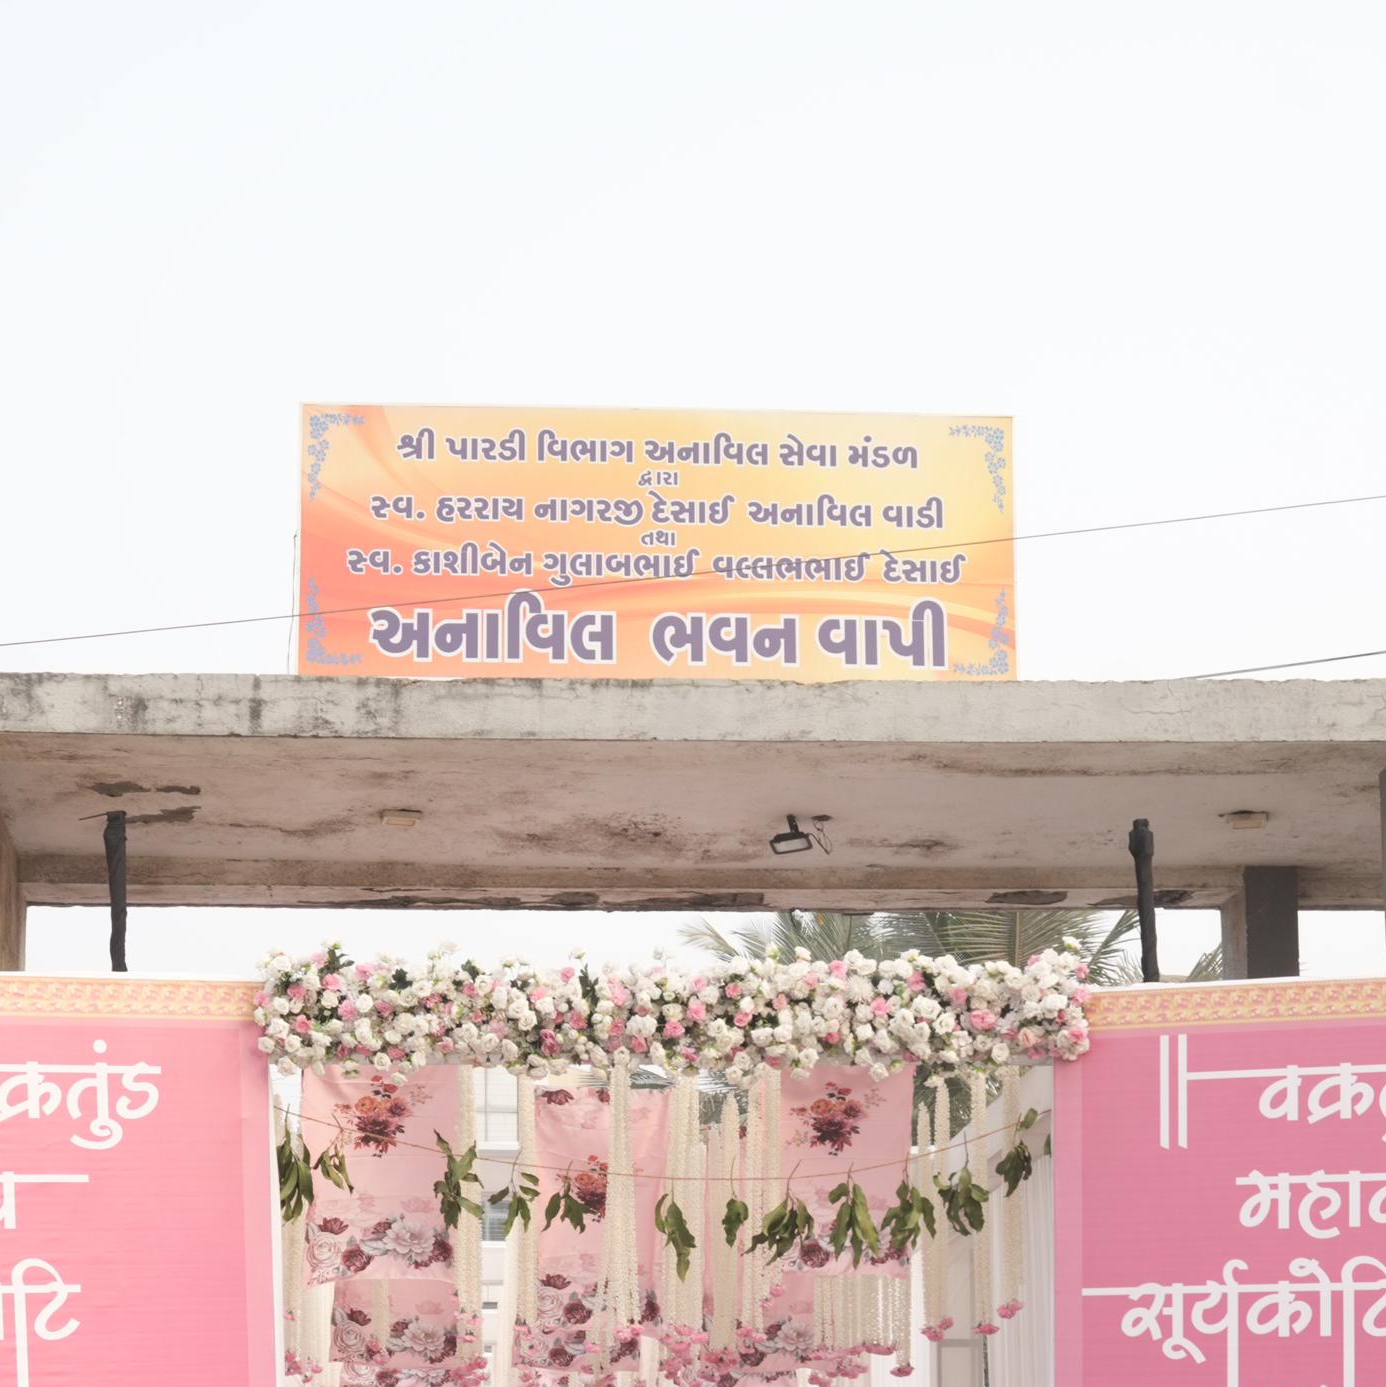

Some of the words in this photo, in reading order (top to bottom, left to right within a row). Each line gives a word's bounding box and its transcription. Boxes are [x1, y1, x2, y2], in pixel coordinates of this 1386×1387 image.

[397, 427, 435, 460] શ્રી
[445, 429, 525, 462] પારડી
[537, 428, 633, 463] વિભાગ
[644, 432, 768, 465] અનાવિલ
[779, 433, 837, 468] સેવા
[848, 435, 918, 469] મંડળ
[638, 470, 679, 486] દ્વારા
[436, 496, 524, 522] હરરાય
[534, 498, 644, 526] નાગરજી
[648, 489, 735, 525] દેસાઈ
[748, 493, 872, 527] અનાવિલ
[882, 495, 944, 529] વાડી
[640, 530, 676, 546] તથા
[412, 541, 533, 575] કાશીબેન
[543, 548, 701, 586] ગુલાબભાઈ
[712, 551, 871, 582] વલ્લભભાઈ
[879, 548, 966, 583] દેસાઈ
[369, 590, 615, 662] અનાવિલ
[651, 613, 798, 665] ભવન
[817, 599, 946, 667] વાપી
